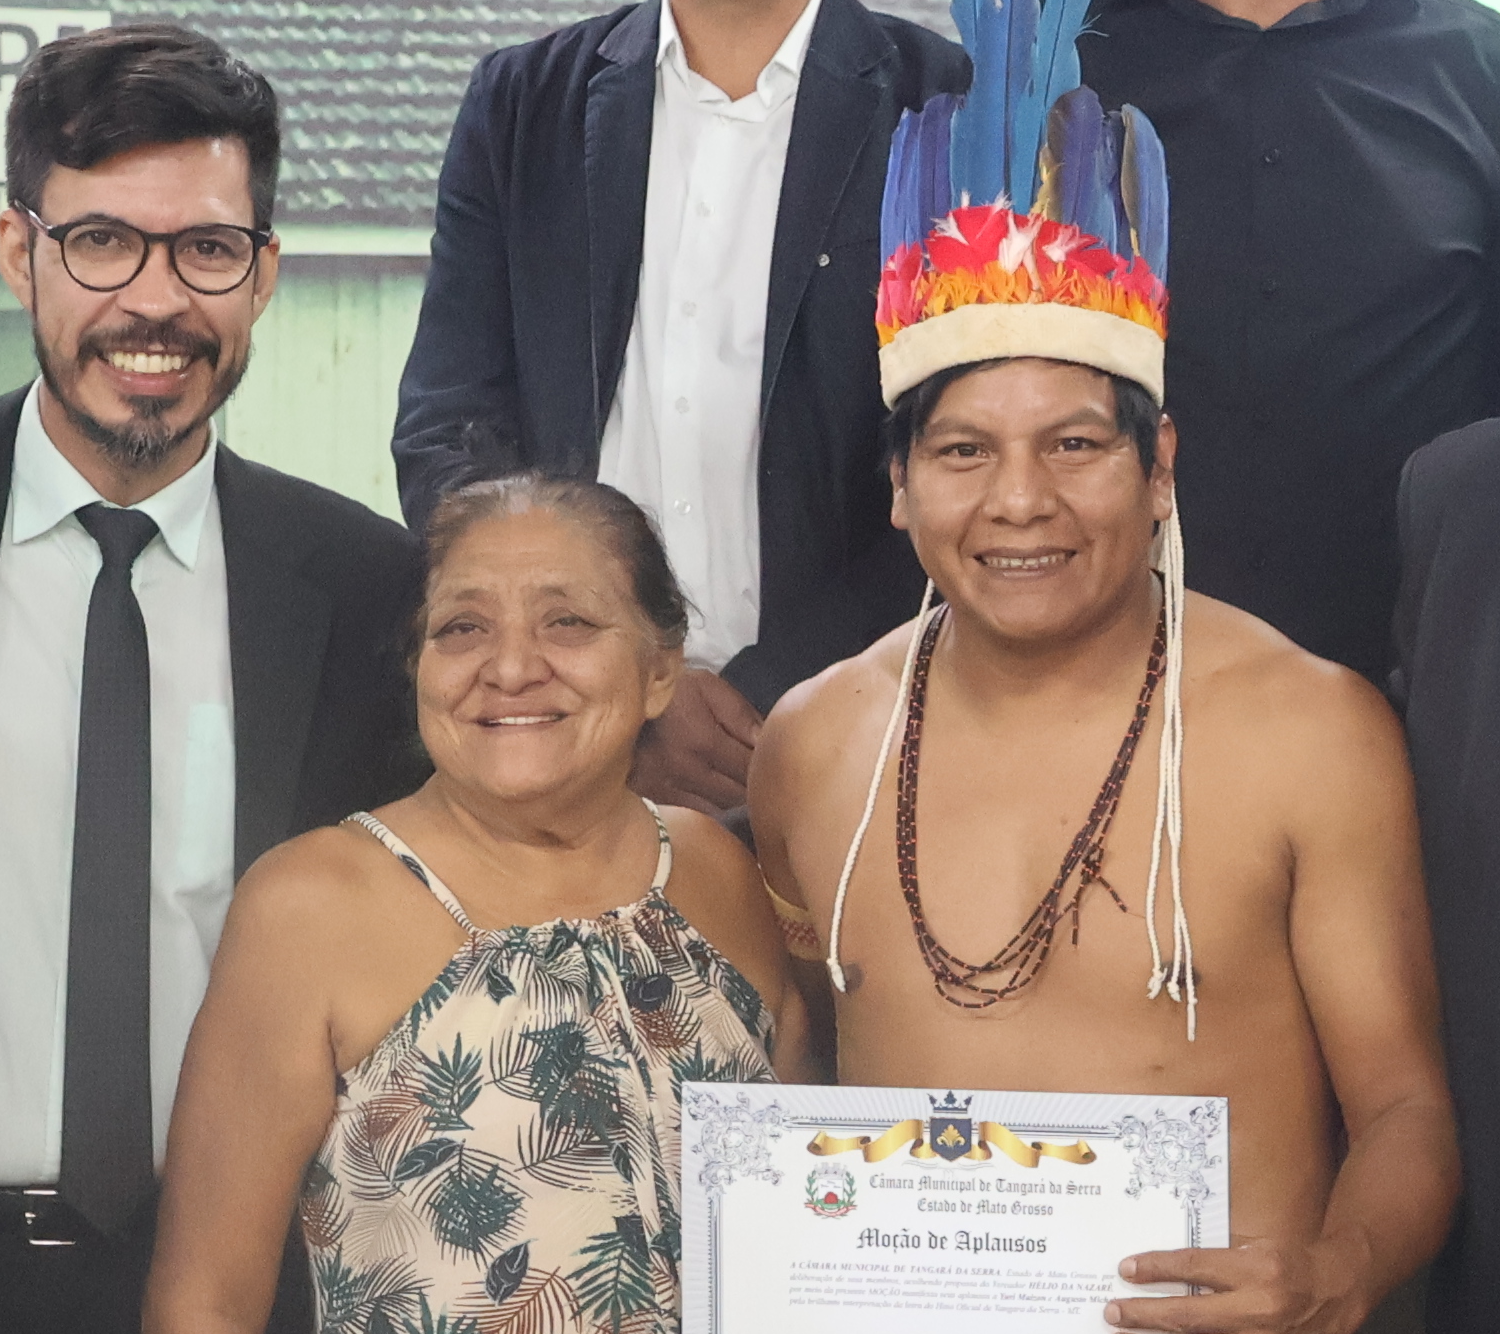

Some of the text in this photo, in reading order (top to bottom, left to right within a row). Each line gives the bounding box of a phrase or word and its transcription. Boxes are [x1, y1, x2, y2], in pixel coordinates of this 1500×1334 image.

[870, 1173, 1101, 1197] Câmara Municipal de Tangará da Serra
[917, 1197, 1053, 1216] Estado de Mato Grosso
[856, 1228, 1047, 1255] Moção de Aplausos
